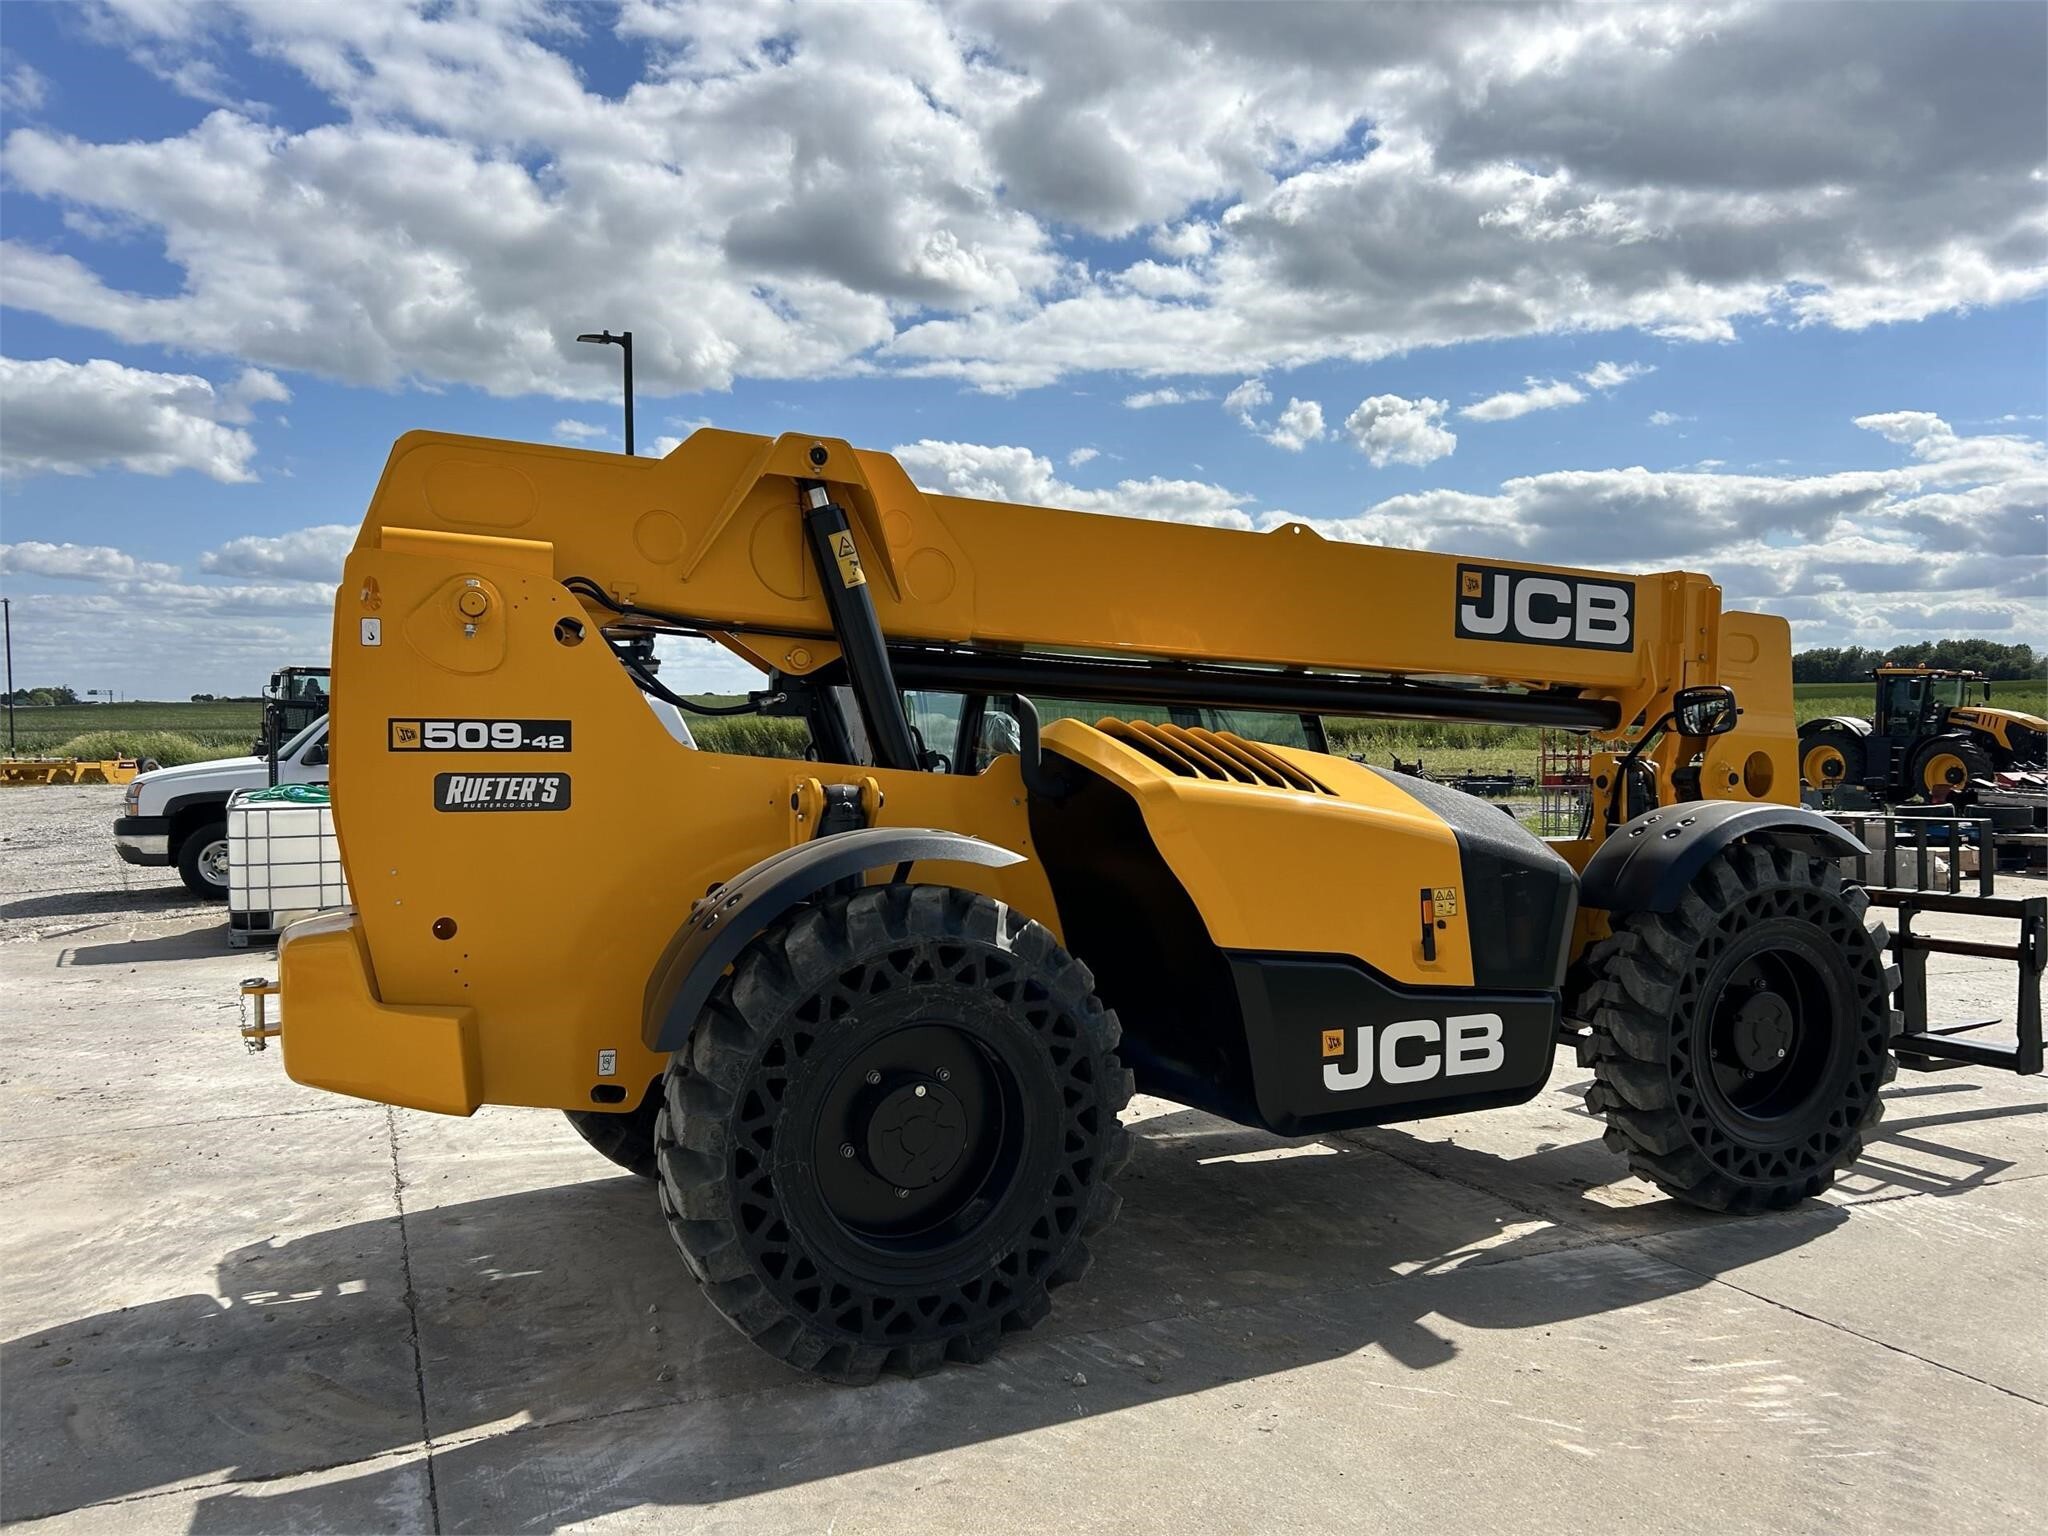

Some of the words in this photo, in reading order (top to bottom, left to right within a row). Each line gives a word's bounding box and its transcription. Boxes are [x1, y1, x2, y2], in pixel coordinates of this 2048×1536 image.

[1461, 574, 1631, 645] JCB
[423, 722, 565, 749] 509-42
[445, 776, 560, 805] RUETER'S
[1323, 1013, 1505, 1091] JCB
